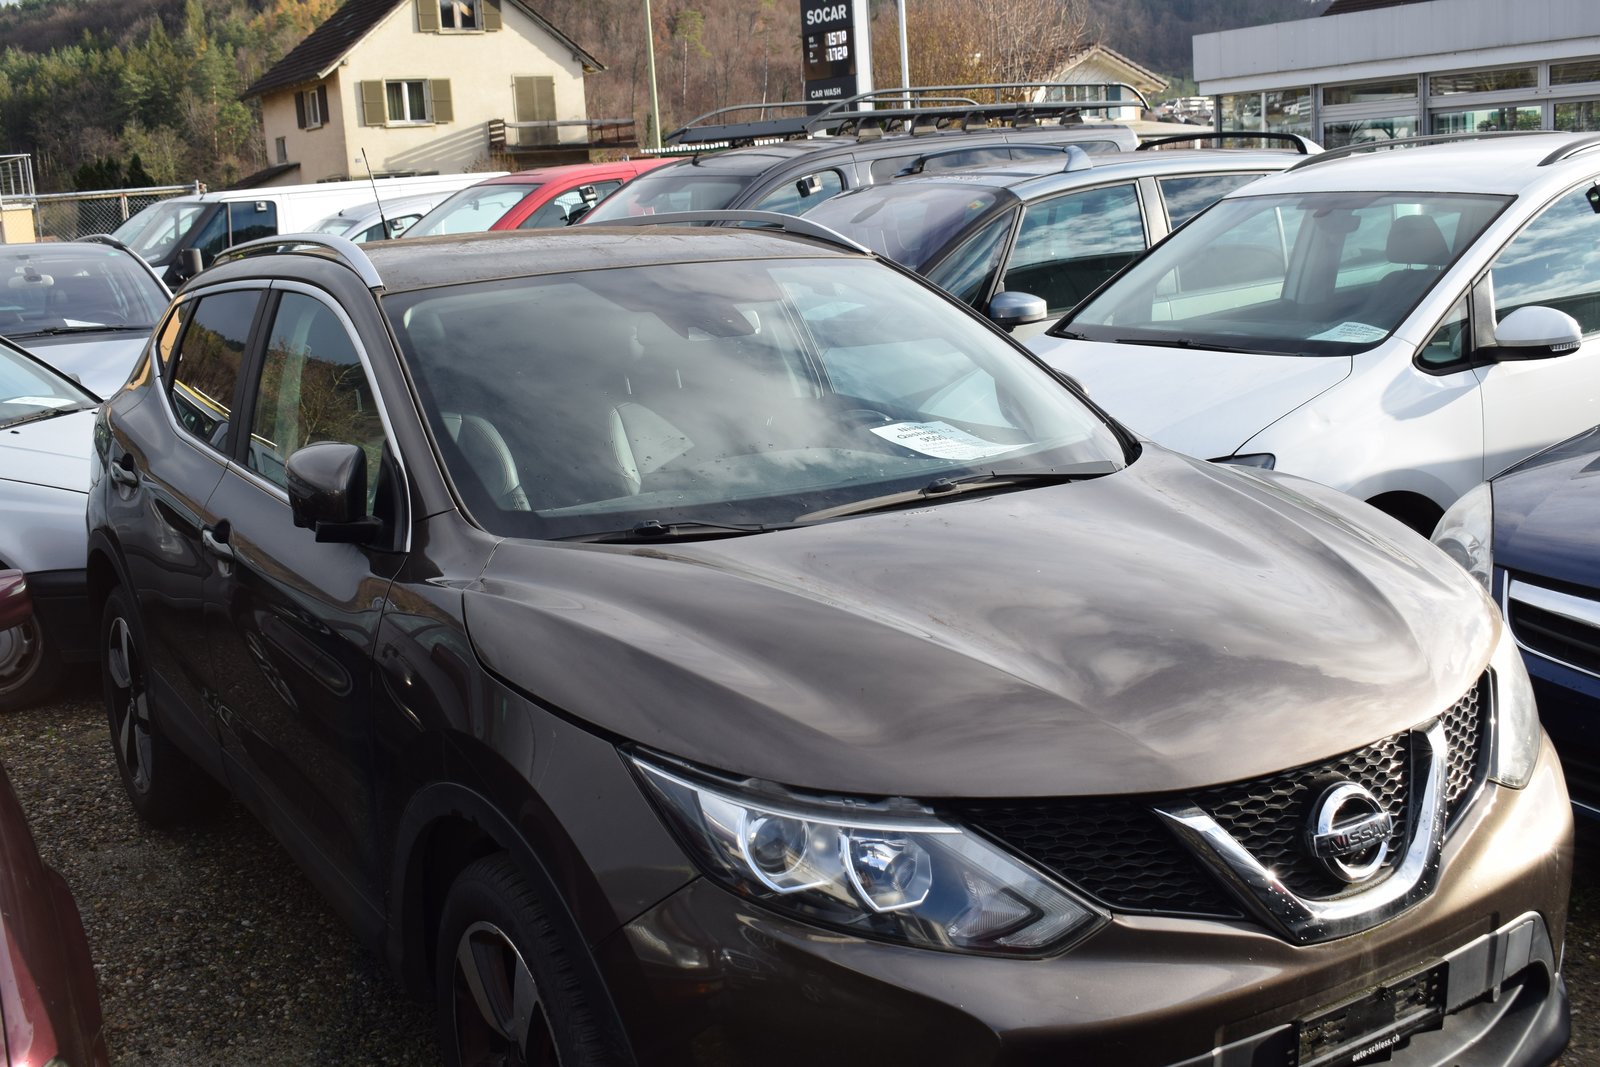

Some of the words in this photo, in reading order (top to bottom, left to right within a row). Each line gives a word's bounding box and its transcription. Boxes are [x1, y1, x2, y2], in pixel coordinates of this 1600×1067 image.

[806, 4, 847, 25] SOCAR
[811, 90, 823, 98] CAR
[824, 88, 841, 96] WASH
[1328, 822, 1391, 852] NISSAN
[1352, 1033, 1400, 1062] auto-schiess.ch
